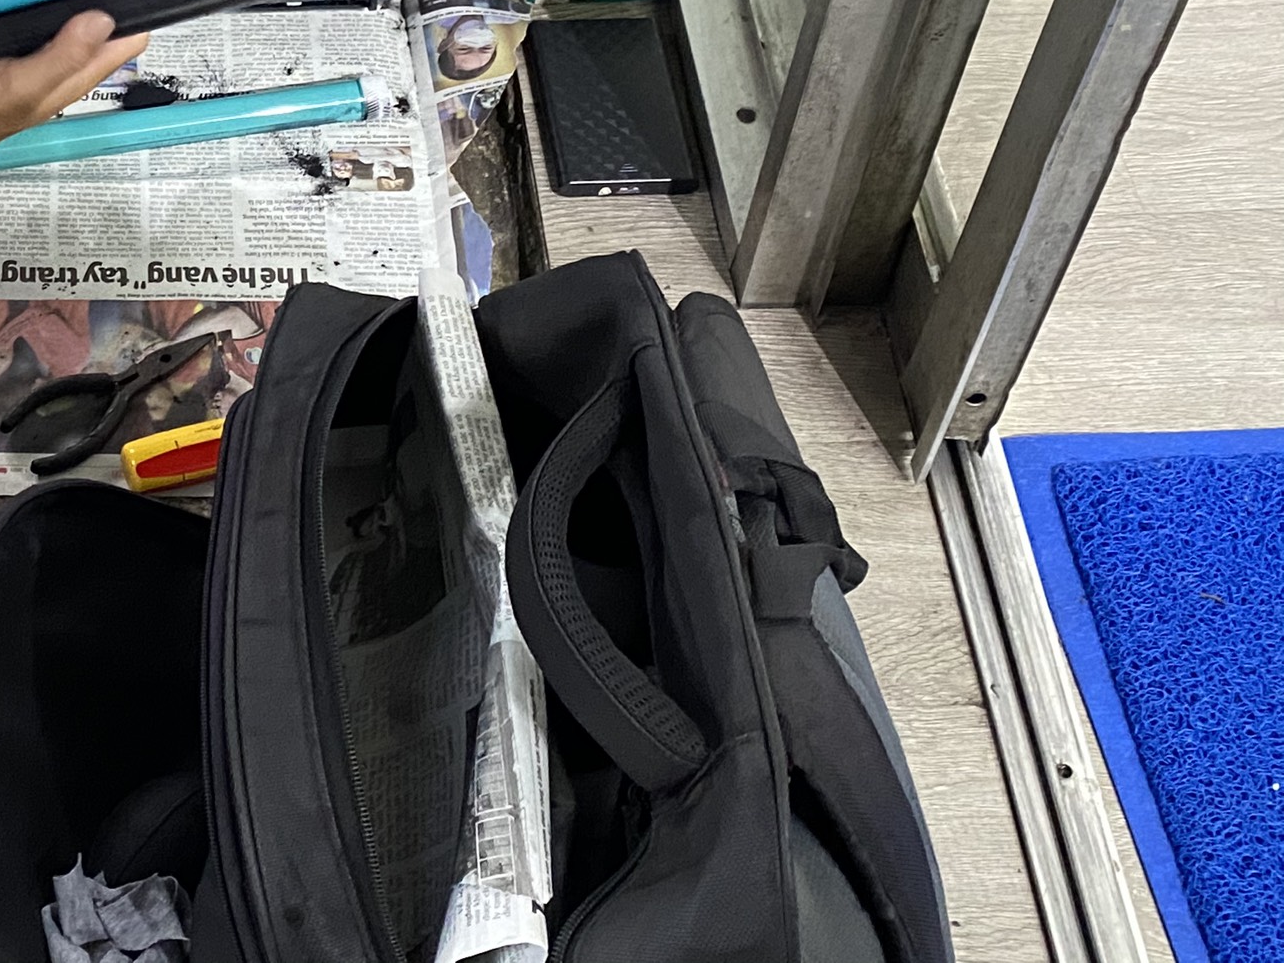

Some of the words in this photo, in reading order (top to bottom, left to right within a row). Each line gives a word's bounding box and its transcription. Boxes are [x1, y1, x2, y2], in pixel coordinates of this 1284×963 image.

[0, 260, 80, 291] trắng
[83, 261, 130, 288] tay
[133, 261, 218, 290] vàng"
[222, 264, 256, 289] hệ
